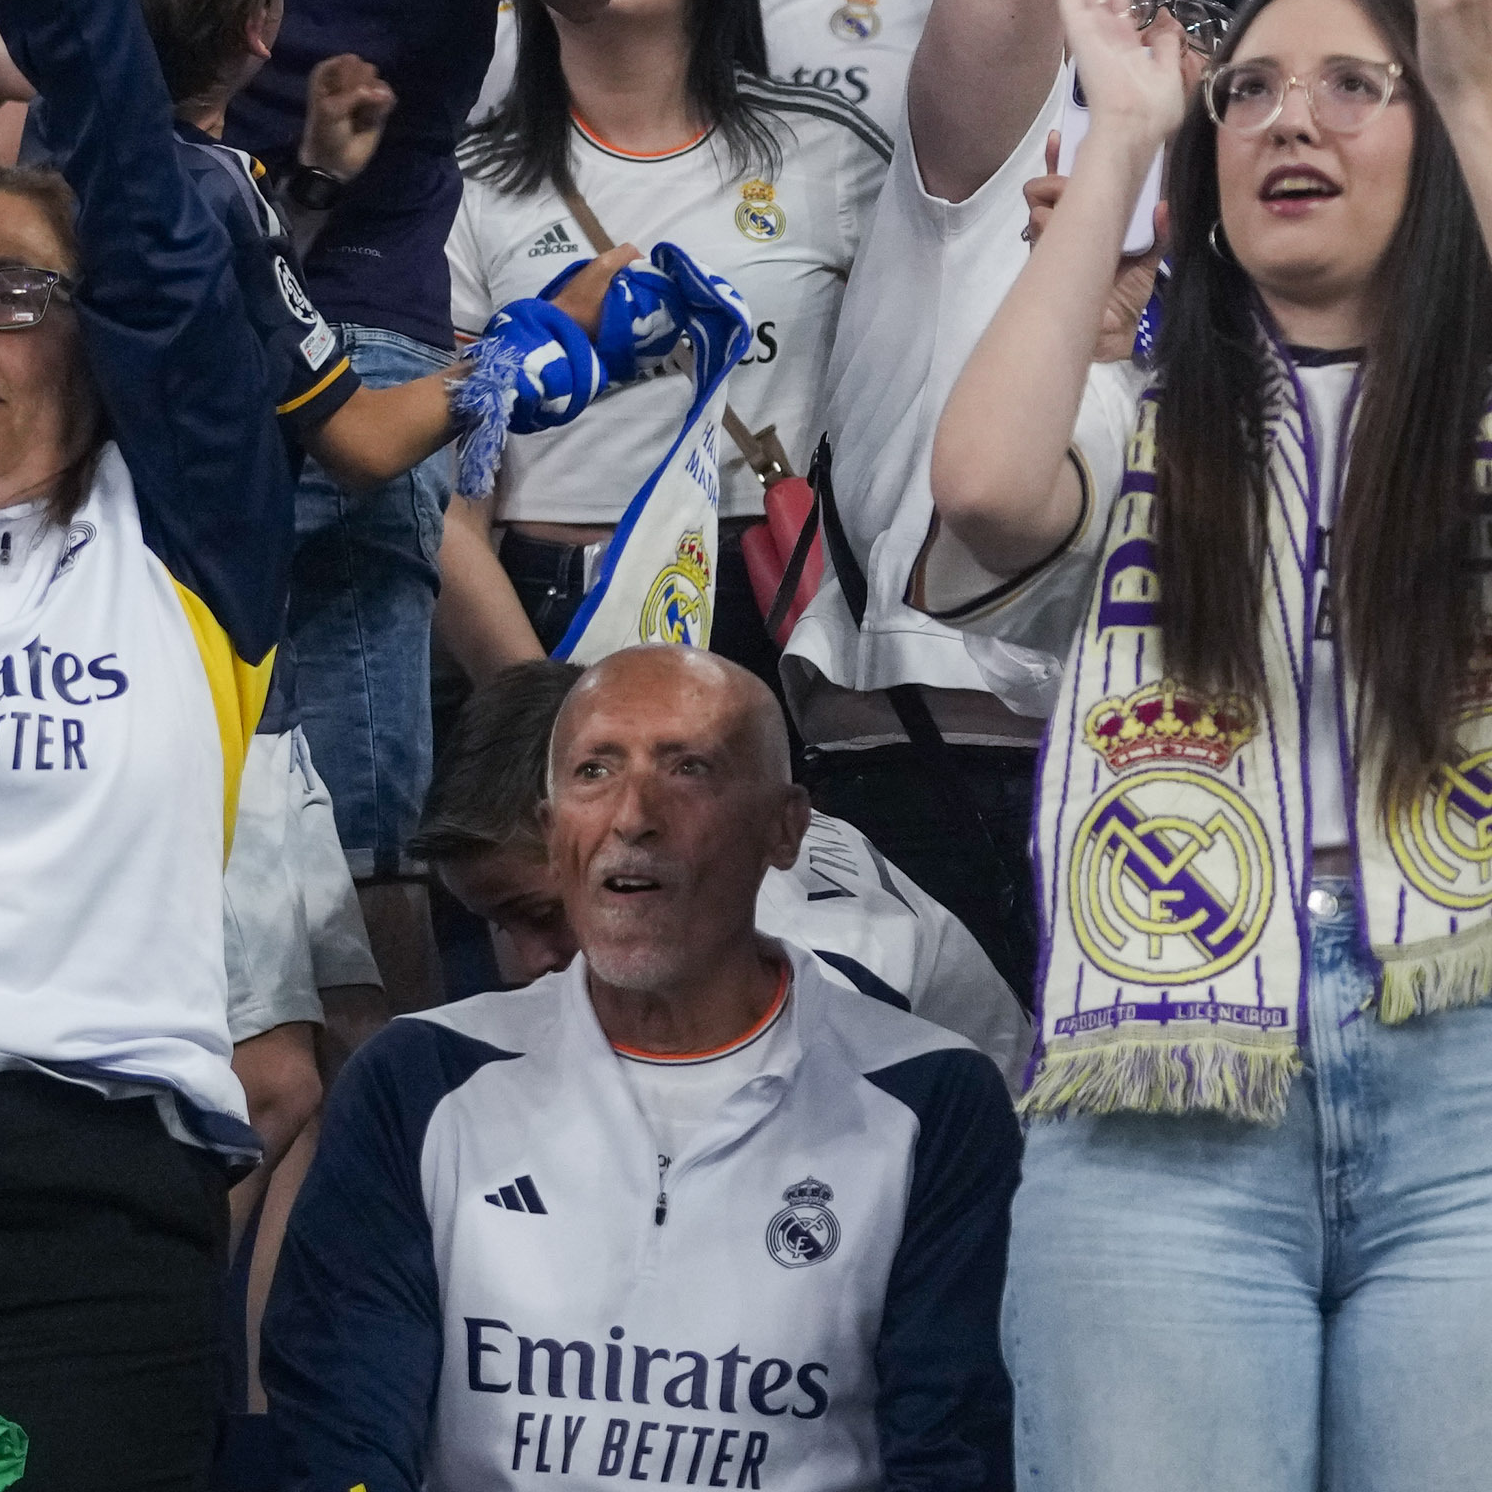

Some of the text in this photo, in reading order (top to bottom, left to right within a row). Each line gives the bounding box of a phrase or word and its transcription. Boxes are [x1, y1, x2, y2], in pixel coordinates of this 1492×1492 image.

[528, 242, 580, 258] adidas
[1059, 1002, 1283, 1033] PRODUCTO LICENCIADO
[462, 1316, 830, 1420] Emirates
[511, 1411, 770, 1490] FLY BETTER
